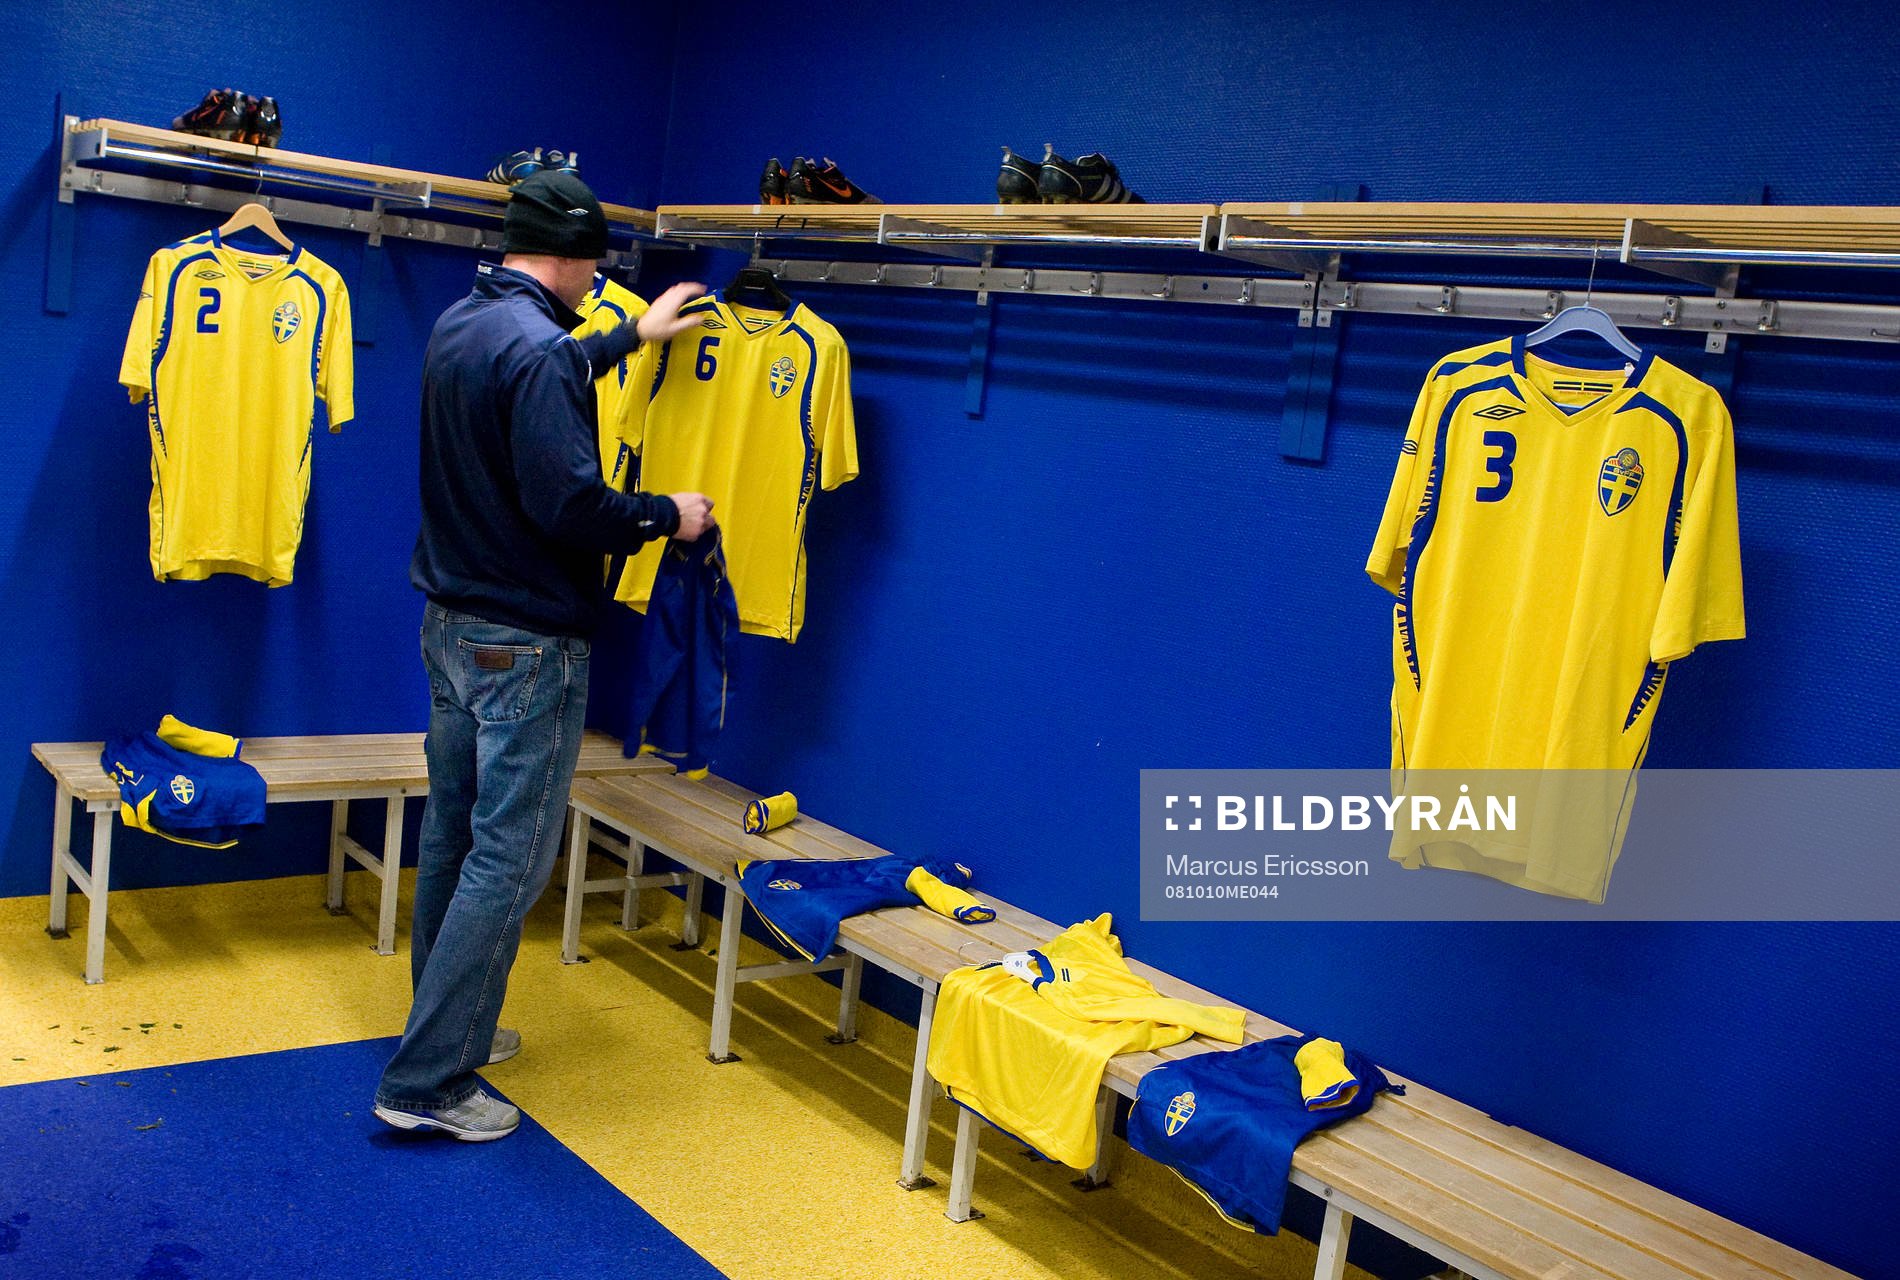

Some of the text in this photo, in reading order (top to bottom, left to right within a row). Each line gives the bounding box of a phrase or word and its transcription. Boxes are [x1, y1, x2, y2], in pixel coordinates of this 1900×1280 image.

[196, 287, 221, 334] 2
[694, 335, 721, 382] 6
[1475, 430, 1517, 503] 3
